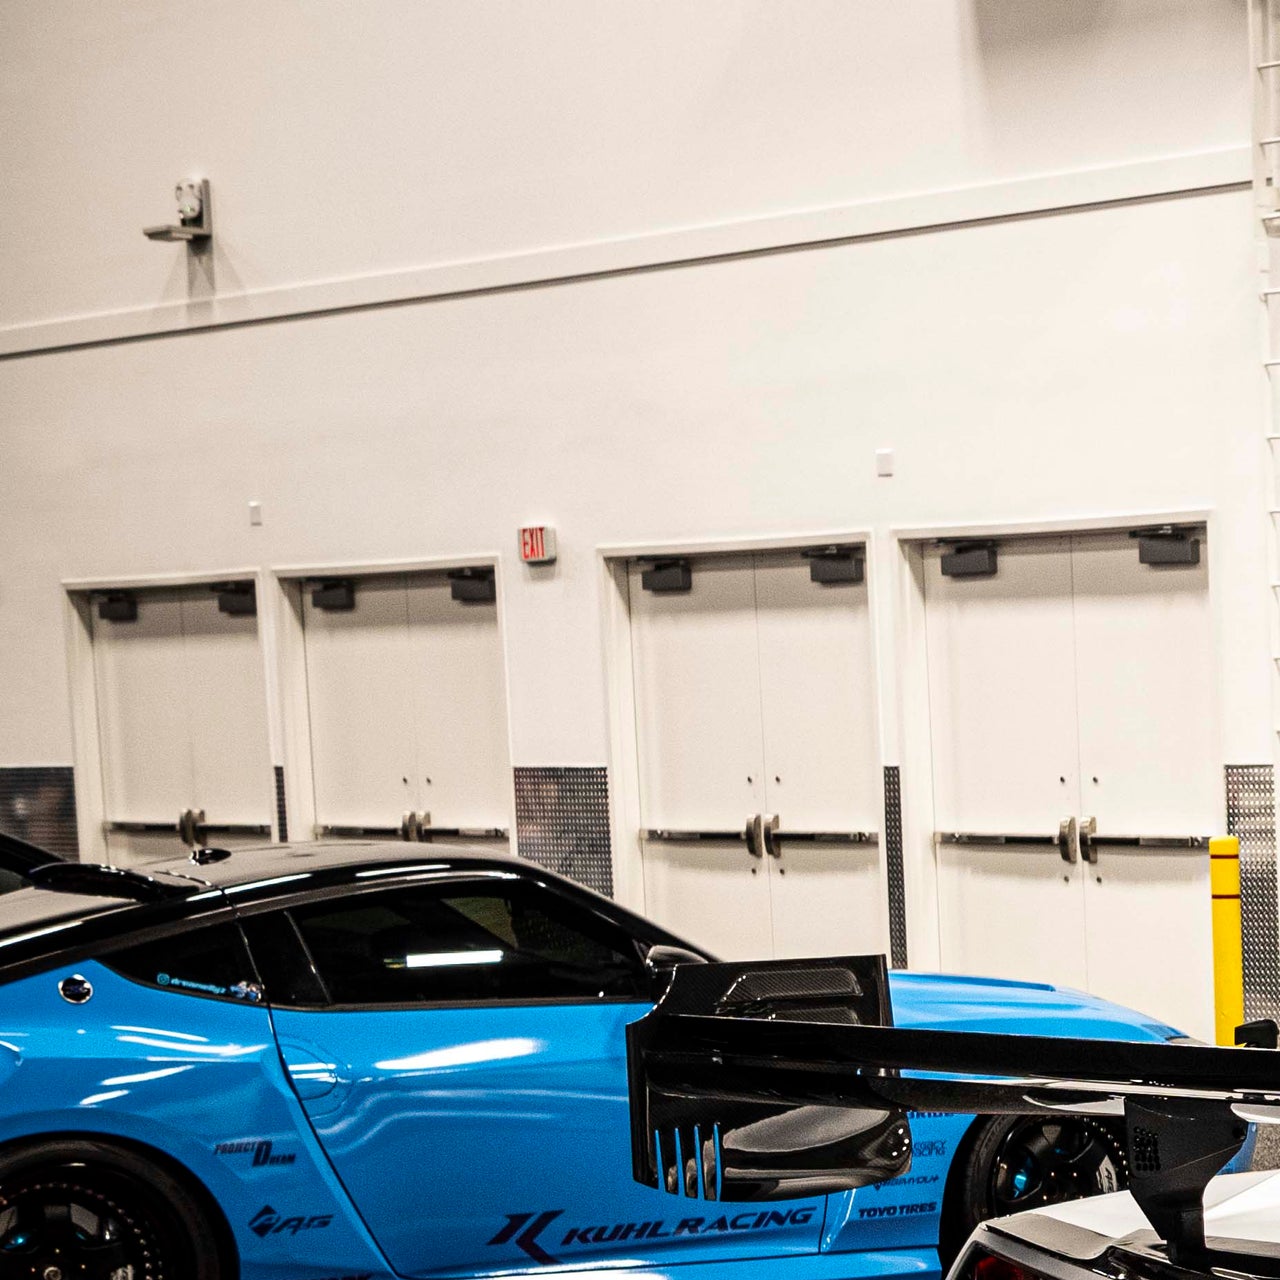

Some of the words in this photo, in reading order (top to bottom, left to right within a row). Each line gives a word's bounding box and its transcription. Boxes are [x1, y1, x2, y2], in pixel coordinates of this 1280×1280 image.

[522, 527, 545, 559] EXIT
[672, 1206, 817, 1236] RACING
[859, 1206, 898, 1218] TOYO
[899, 1202, 937, 1214] TIRES
